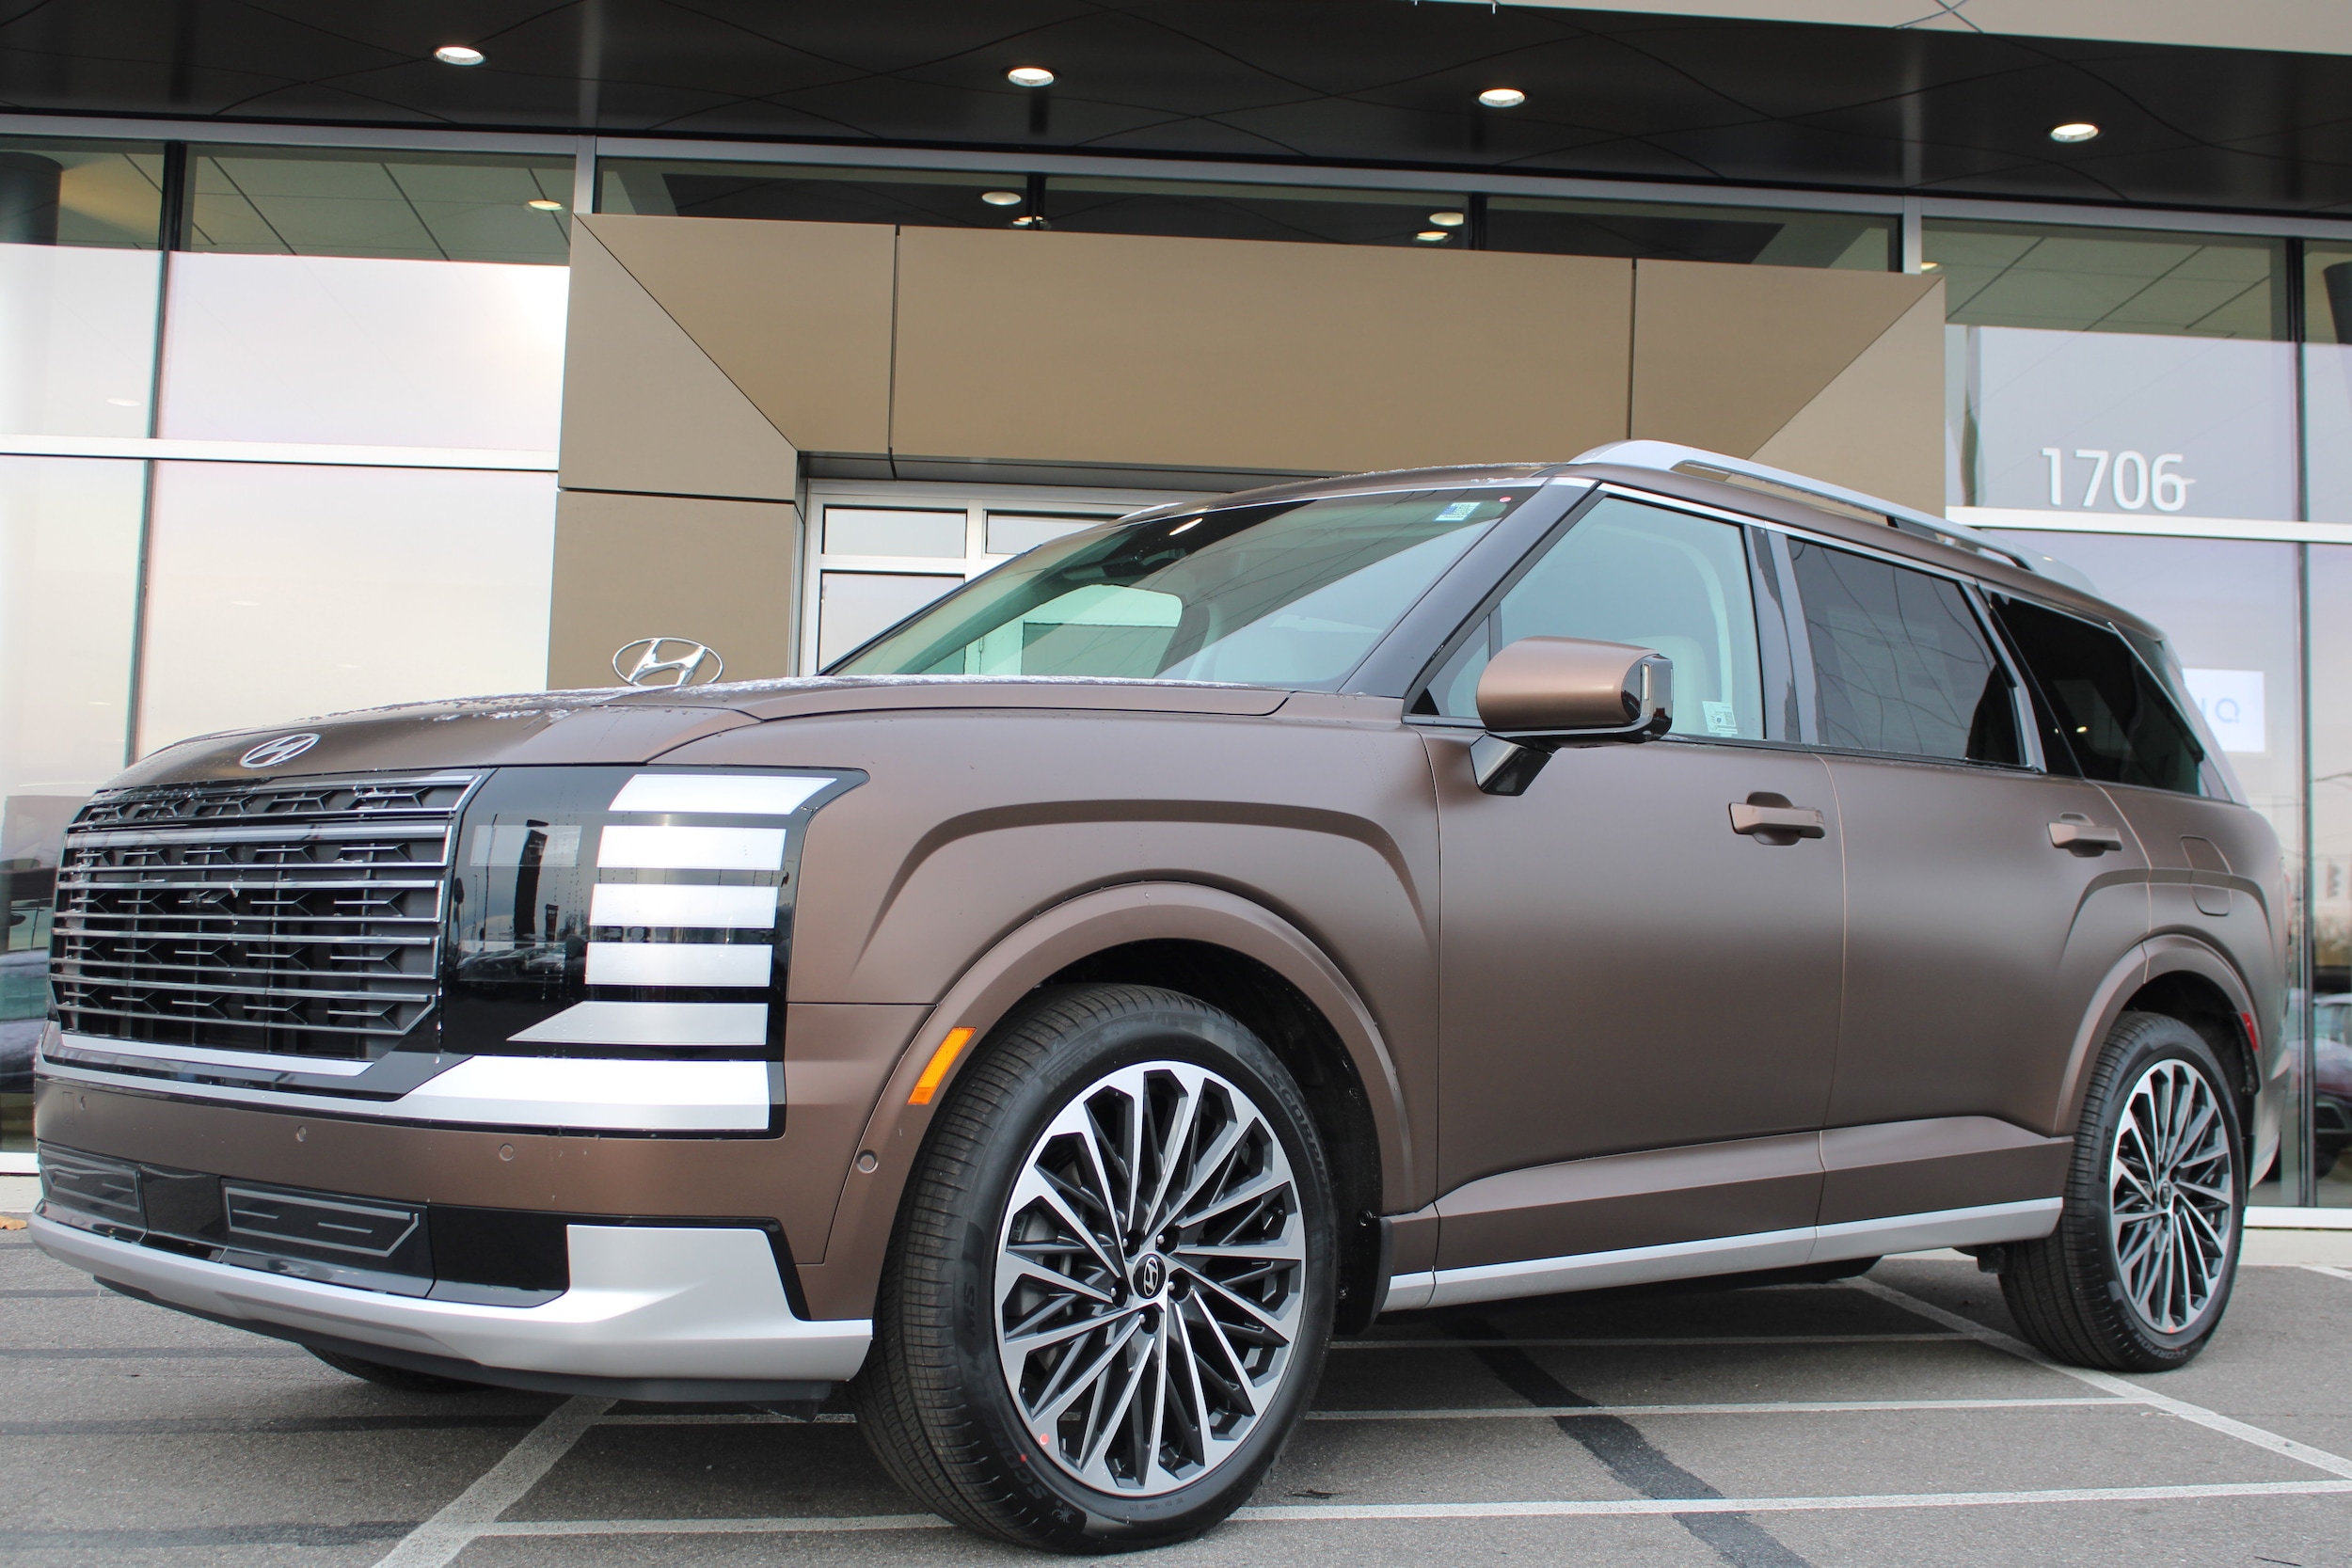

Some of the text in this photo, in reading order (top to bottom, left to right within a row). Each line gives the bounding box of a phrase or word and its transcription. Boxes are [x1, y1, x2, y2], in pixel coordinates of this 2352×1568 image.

[2041, 447, 2186, 512] 1706
[1268, 1071, 1332, 1208] SCORPION
[2134, 1334, 2188, 1359] SCORPION
